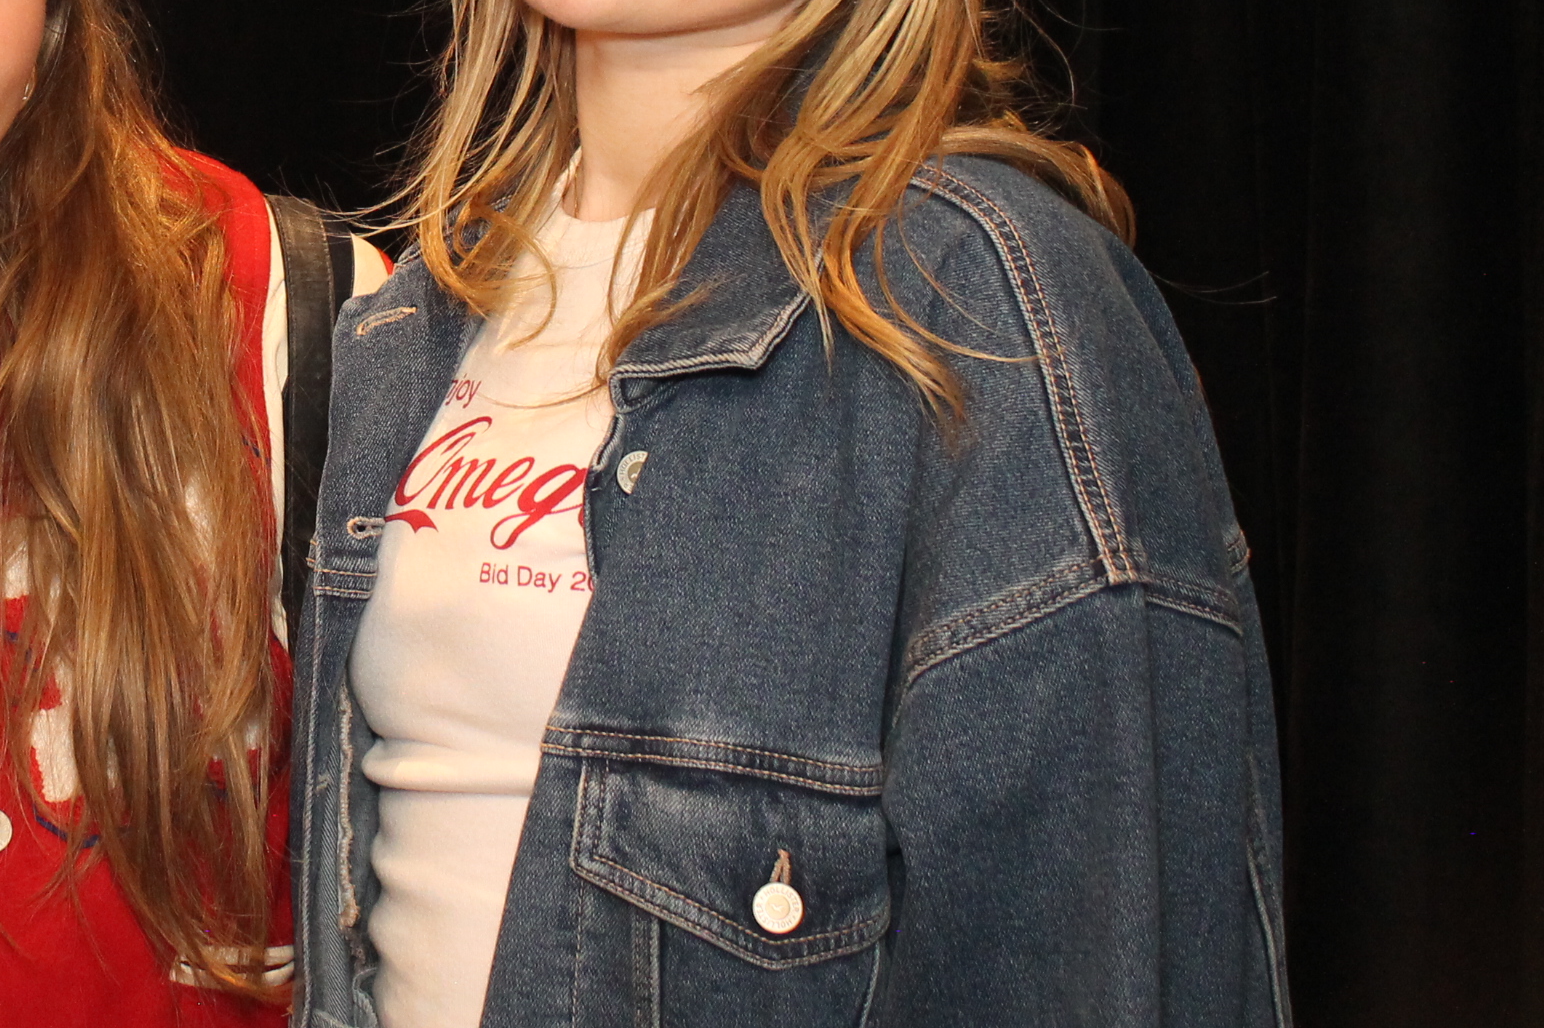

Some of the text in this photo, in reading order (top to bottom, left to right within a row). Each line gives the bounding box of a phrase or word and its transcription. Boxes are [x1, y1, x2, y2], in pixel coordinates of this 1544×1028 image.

[619, 453, 646, 475] HOLLIST
[393, 416, 588, 550] Omeg
[479, 562, 509, 585] Bid
[517, 566, 562, 593] Day
